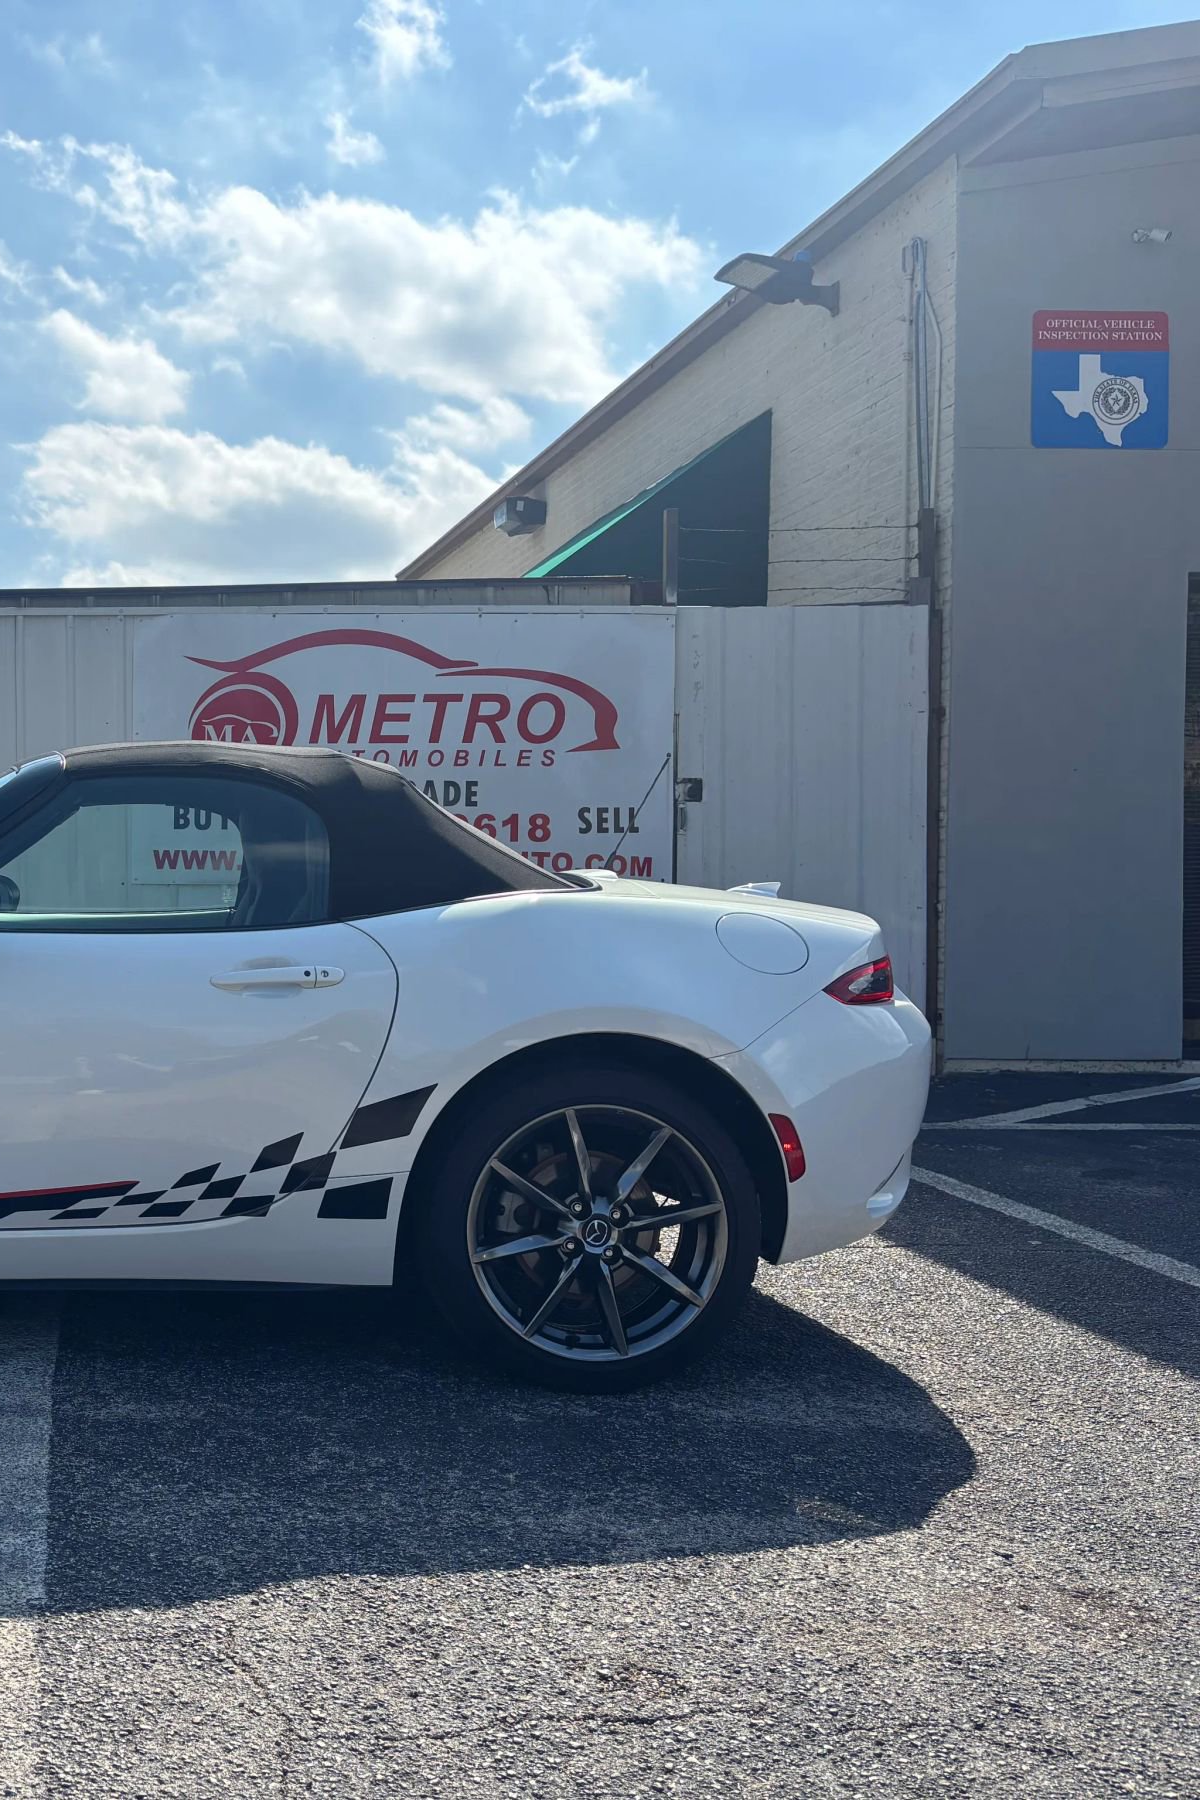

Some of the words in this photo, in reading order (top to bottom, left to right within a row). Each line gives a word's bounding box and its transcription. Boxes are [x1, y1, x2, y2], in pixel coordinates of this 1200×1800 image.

[1046, 319, 1101, 329] OFFICIAL
[1103, 319, 1155, 329] VEHICLE
[1038, 331, 1109, 341] INSPECTION
[1112, 331, 1162, 341] STATION
[308, 692, 567, 745] METRO
[201, 724, 258, 745] MA
[337, 749, 556, 768] TOMOBILES
[409, 780, 479, 808] ADE
[454, 813, 552, 843] 618
[577, 806, 640, 835] SELL
[153, 849, 242, 871] WWW.
